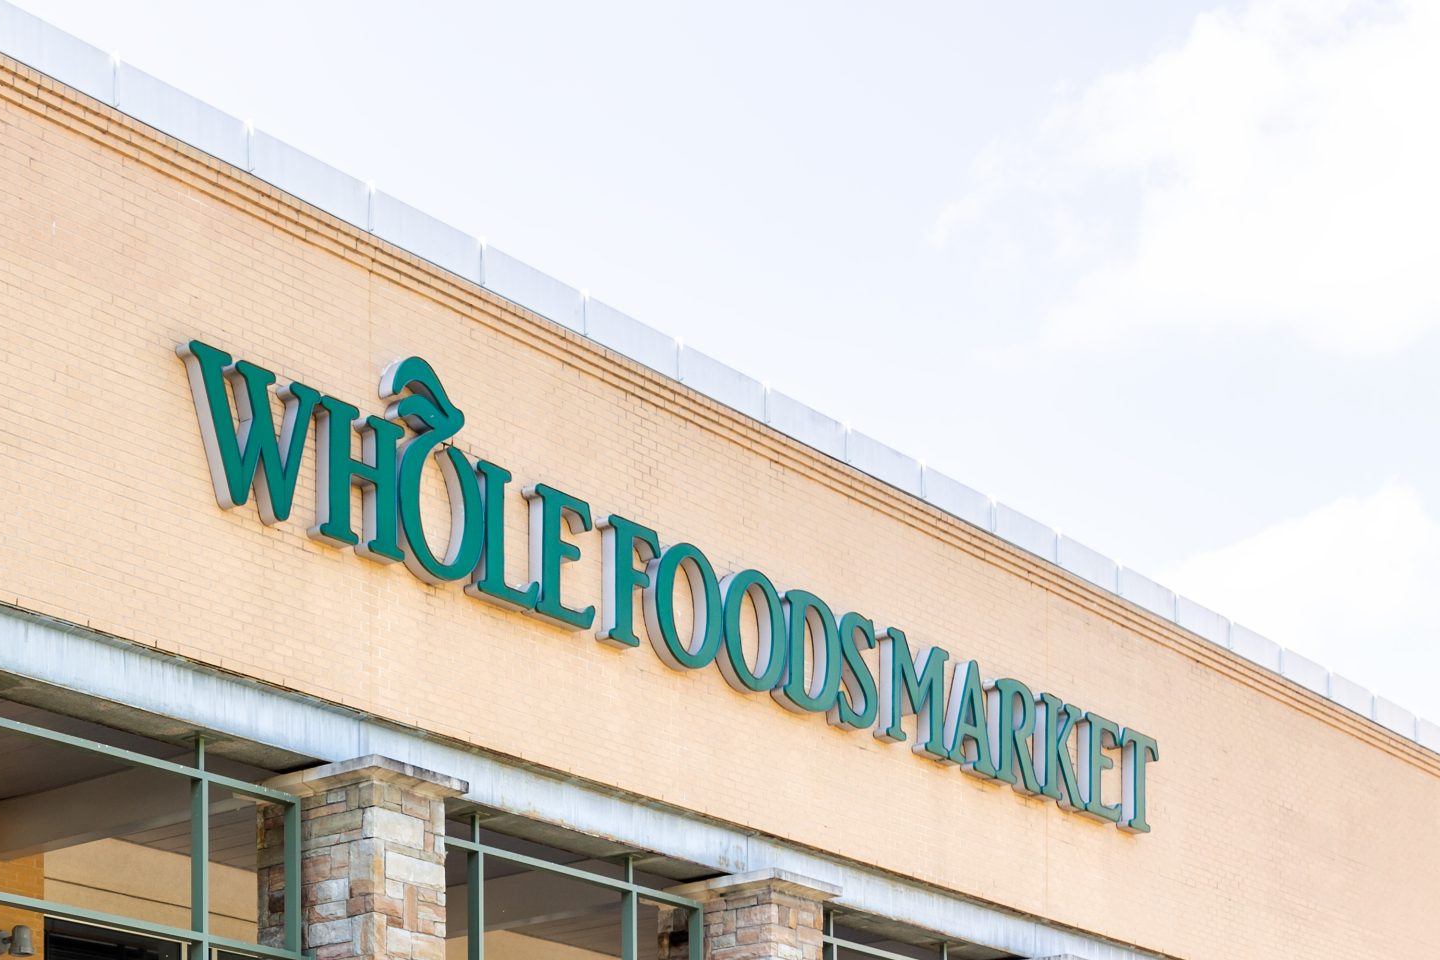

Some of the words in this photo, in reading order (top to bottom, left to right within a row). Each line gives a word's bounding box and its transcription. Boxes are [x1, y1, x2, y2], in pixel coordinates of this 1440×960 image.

[175, 339, 596, 632] WHOLE
[595, 514, 876, 732] FOODS
[872, 626, 1159, 834] MARKET
